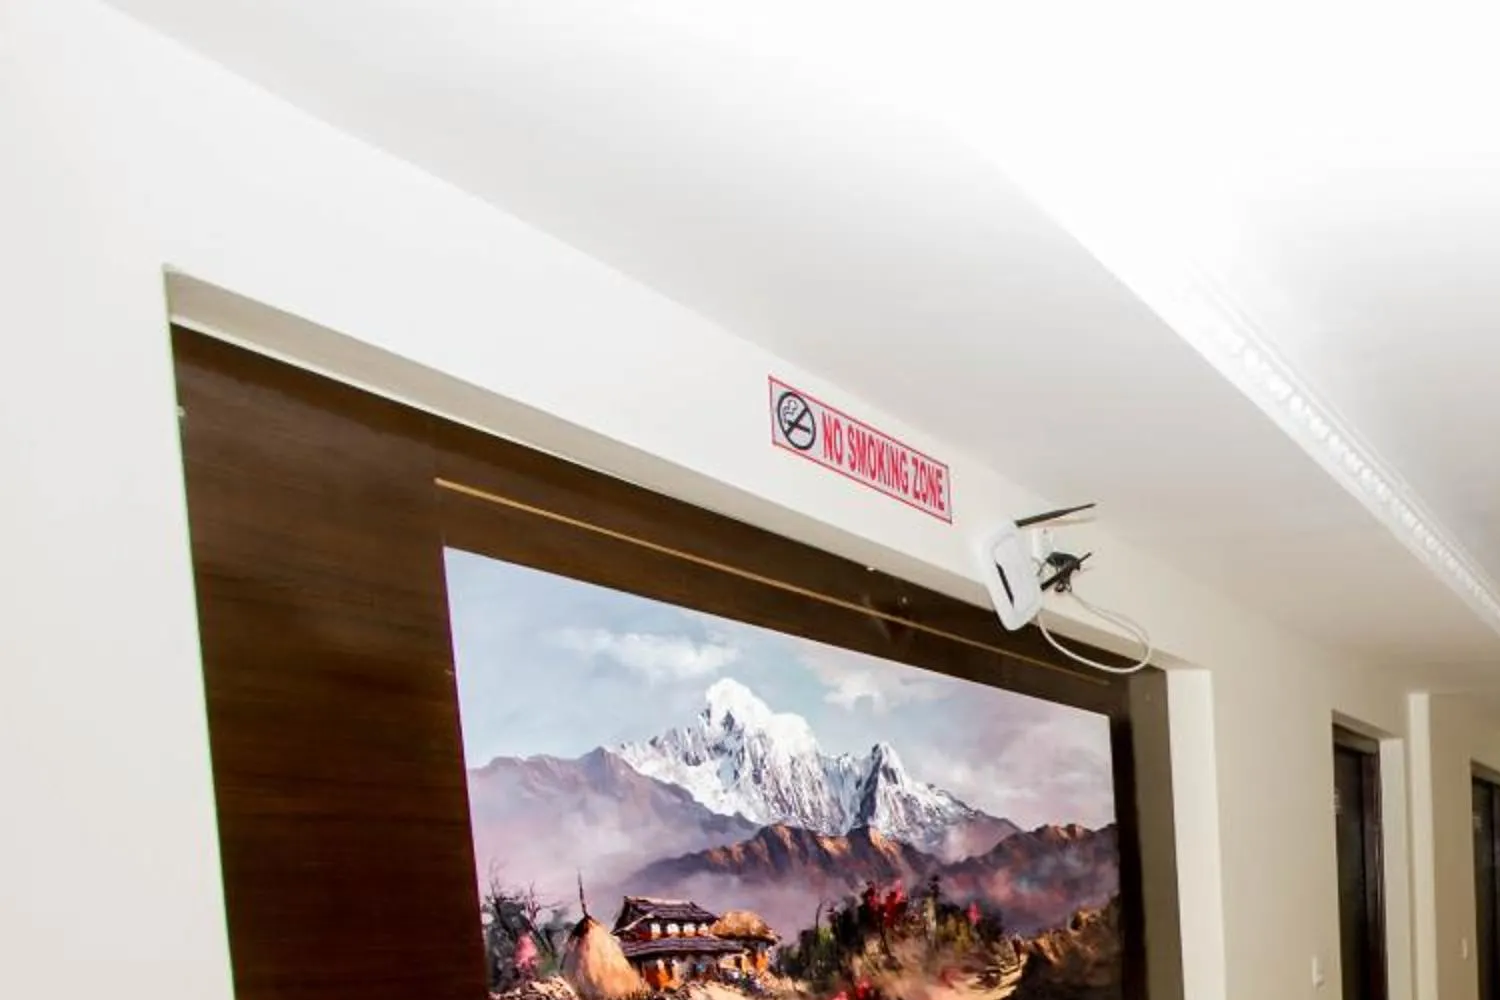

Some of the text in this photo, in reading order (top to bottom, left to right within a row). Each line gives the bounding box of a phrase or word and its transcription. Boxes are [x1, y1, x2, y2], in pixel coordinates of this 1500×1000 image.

[822, 411, 944, 510] NO SMOKING ZONE
